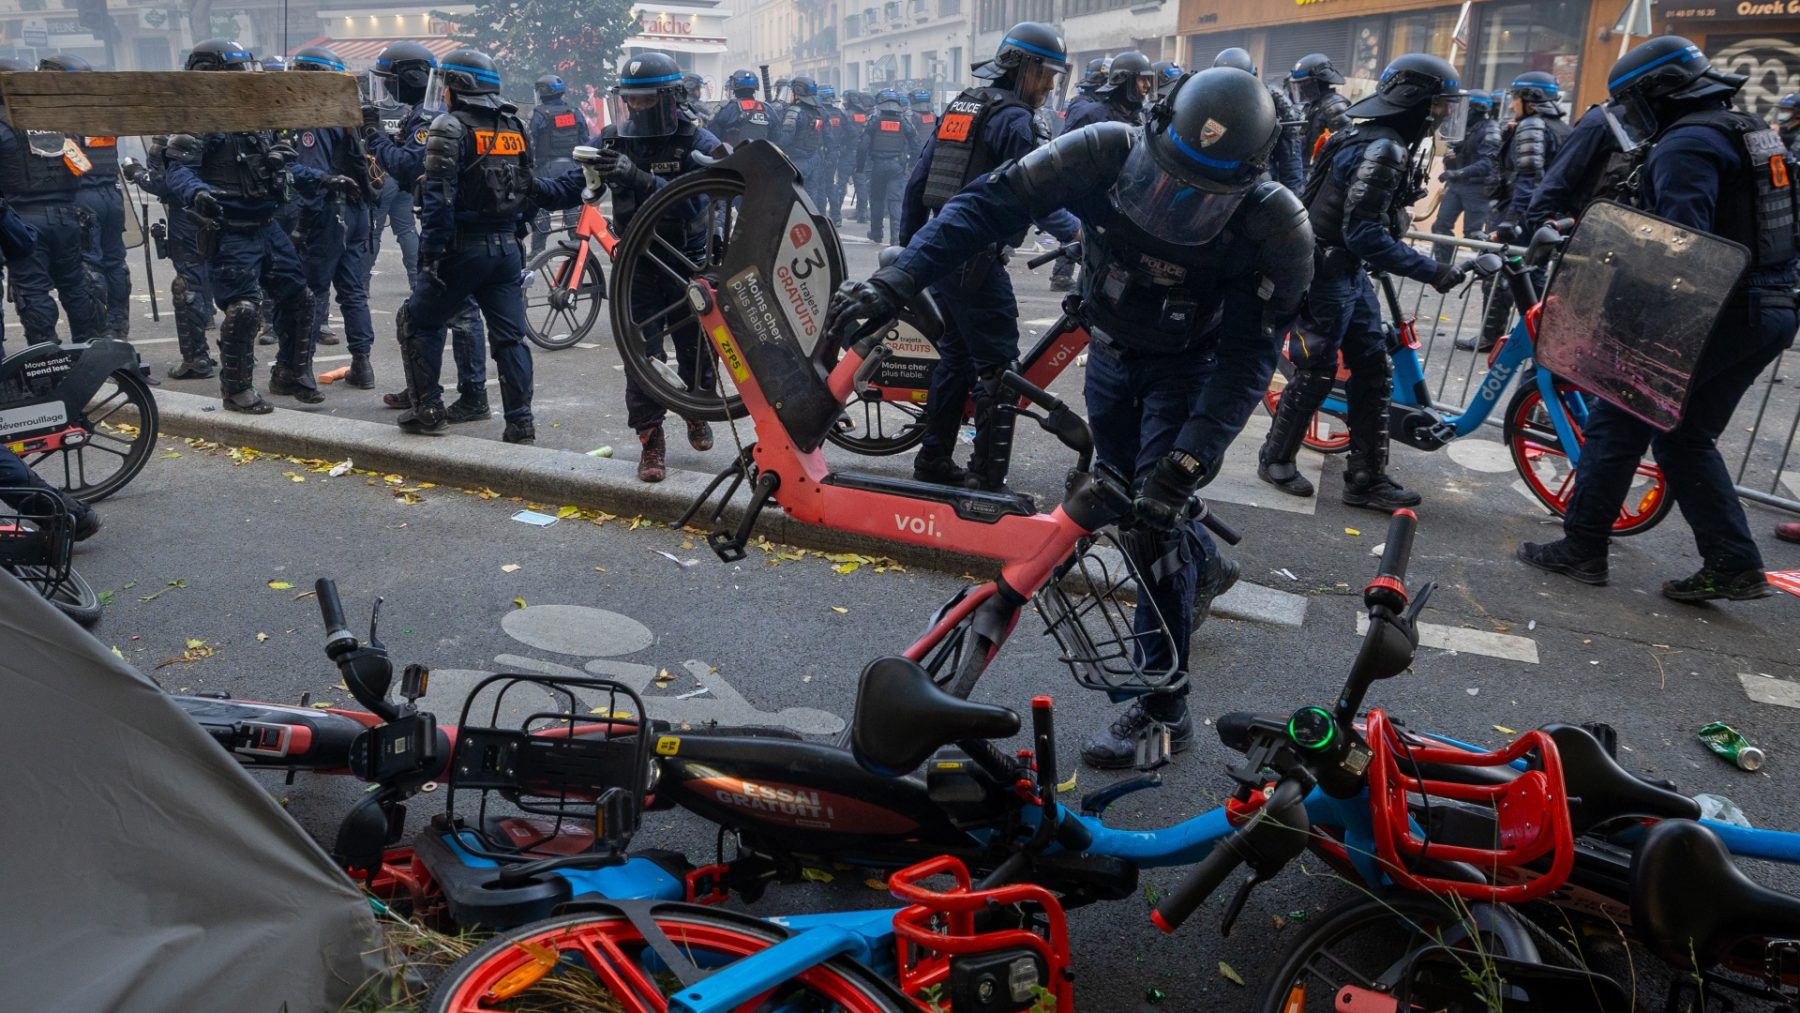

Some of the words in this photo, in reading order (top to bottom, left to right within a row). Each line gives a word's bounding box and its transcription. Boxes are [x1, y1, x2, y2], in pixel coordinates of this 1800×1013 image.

[1737, 1, 1784, 15] Ossek
[1787, 0, 1800, 14] G
[639, 15, 692, 34] raîche
[951, 101, 982, 114] POLICE
[944, 120, 965, 134] C21
[502, 135, 523, 150] 331
[791, 248, 826, 280] 3
[1140, 254, 1184, 277] POLICE
[744, 272, 768, 312] Moins
[763, 311, 783, 345] cher,
[777, 266, 818, 337] GRATUITS
[799, 281, 819, 316] trajets
[731, 281, 751, 307] plus
[746, 306, 768, 345] fiable.
[24, 361, 46, 370] Move
[721, 340, 741, 369] ZFP5
[881, 361, 907, 369] Moins
[1048, 344, 1076, 369] voi.
[26, 367, 52, 377] spend
[881, 370, 899, 378] plus
[1482, 363, 1512, 400] dott
[894, 513, 942, 537] voi.
[715, 790, 822, 818] GRATUIT
[742, 781, 820, 806] ESSAI
